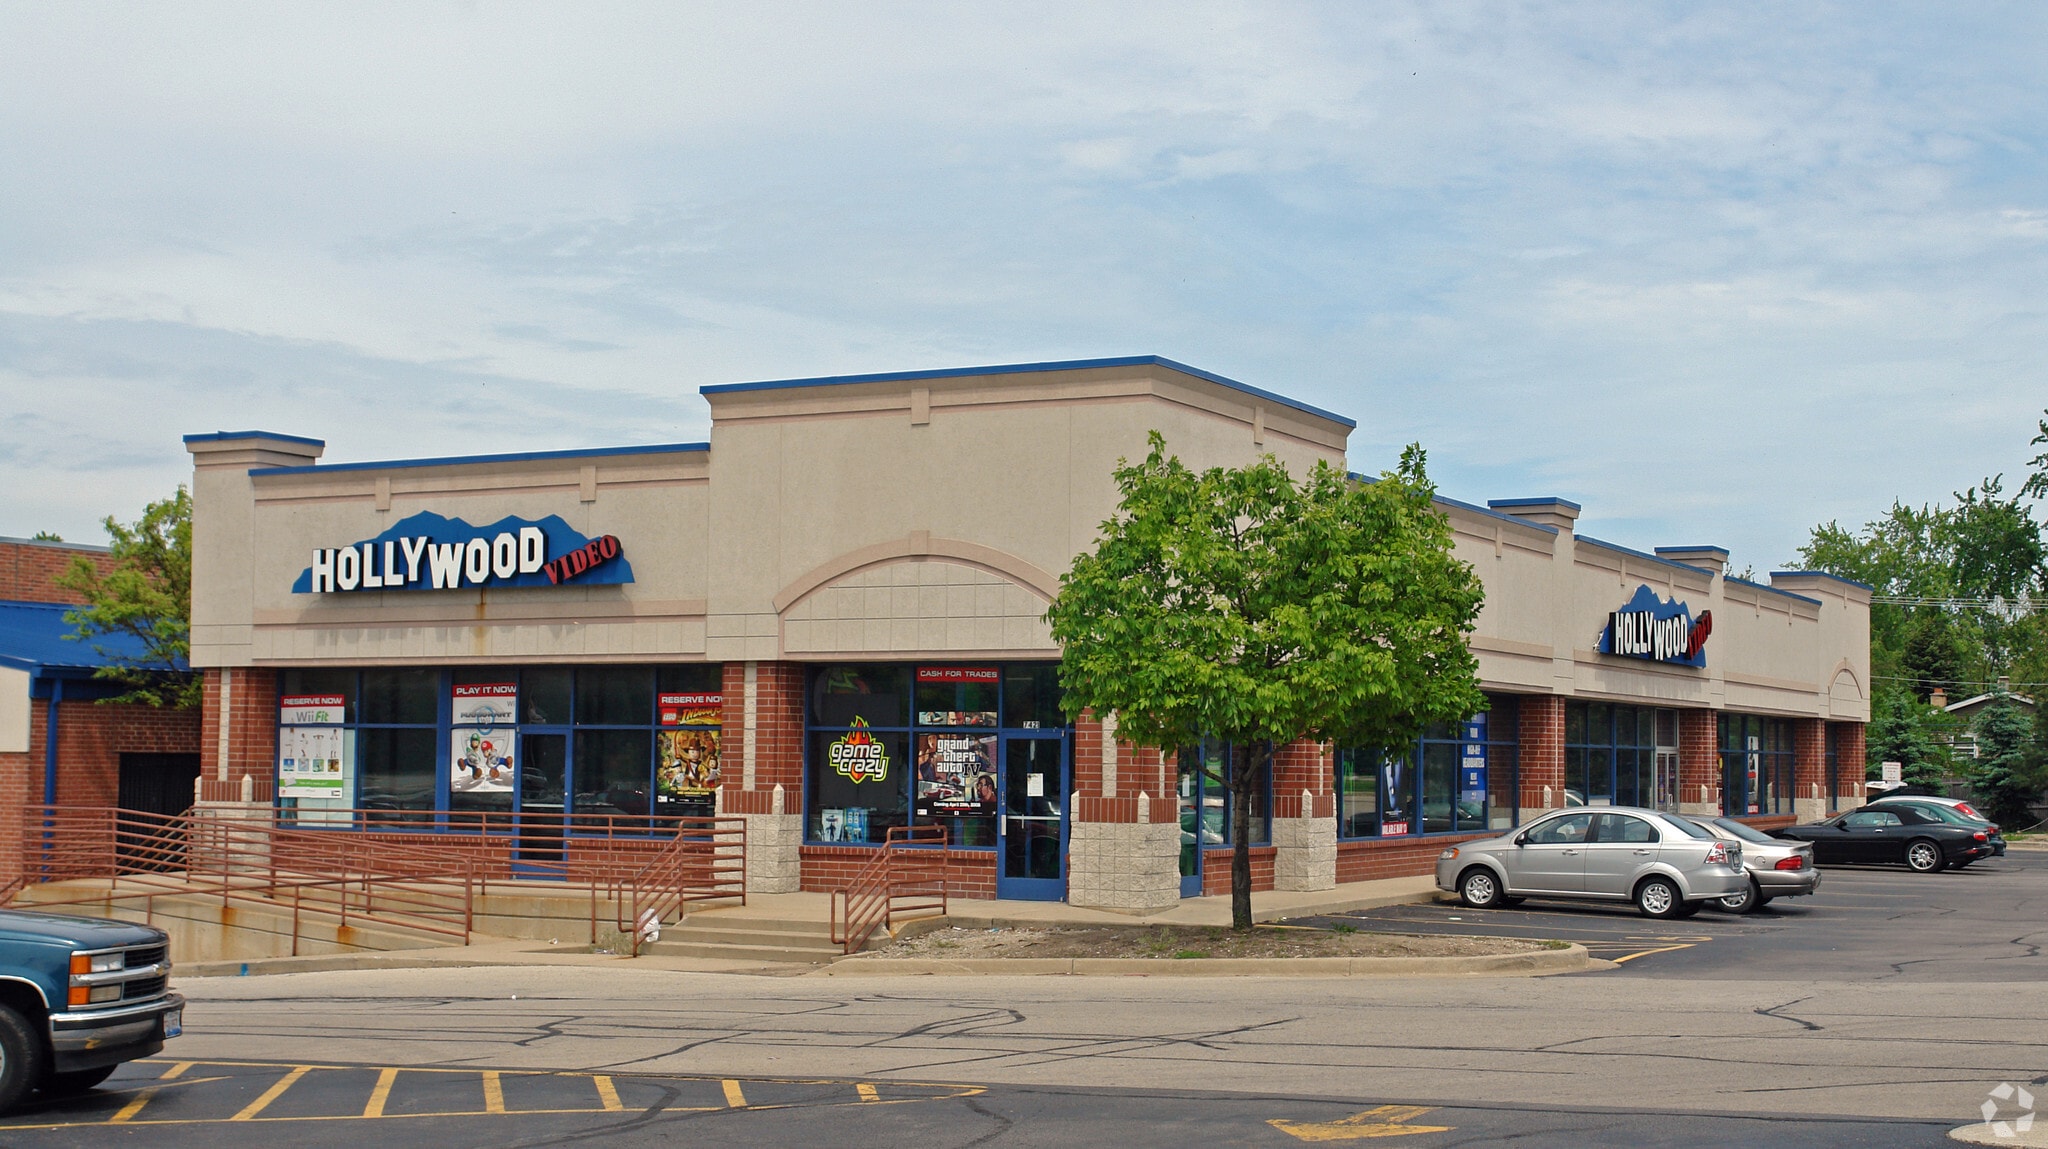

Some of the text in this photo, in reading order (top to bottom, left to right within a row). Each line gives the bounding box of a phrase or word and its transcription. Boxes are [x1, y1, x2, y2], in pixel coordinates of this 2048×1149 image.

[312, 527, 621, 593] HOLLYWOOD VIDEO
[1615, 611, 1687, 660] HOLLYWOOD
[920, 670, 998, 679] CASH FOR TRADES
[456, 685, 517, 695] PLAY IT NOW
[706, 695, 723, 703] NO
[296, 711, 329, 722] Wii Fit
[937, 738, 970, 752] grand
[831, 744, 882, 763] game
[942, 750, 976, 762] theft
[839, 758, 886, 778] crazy
[936, 762, 982, 778] auto IV
